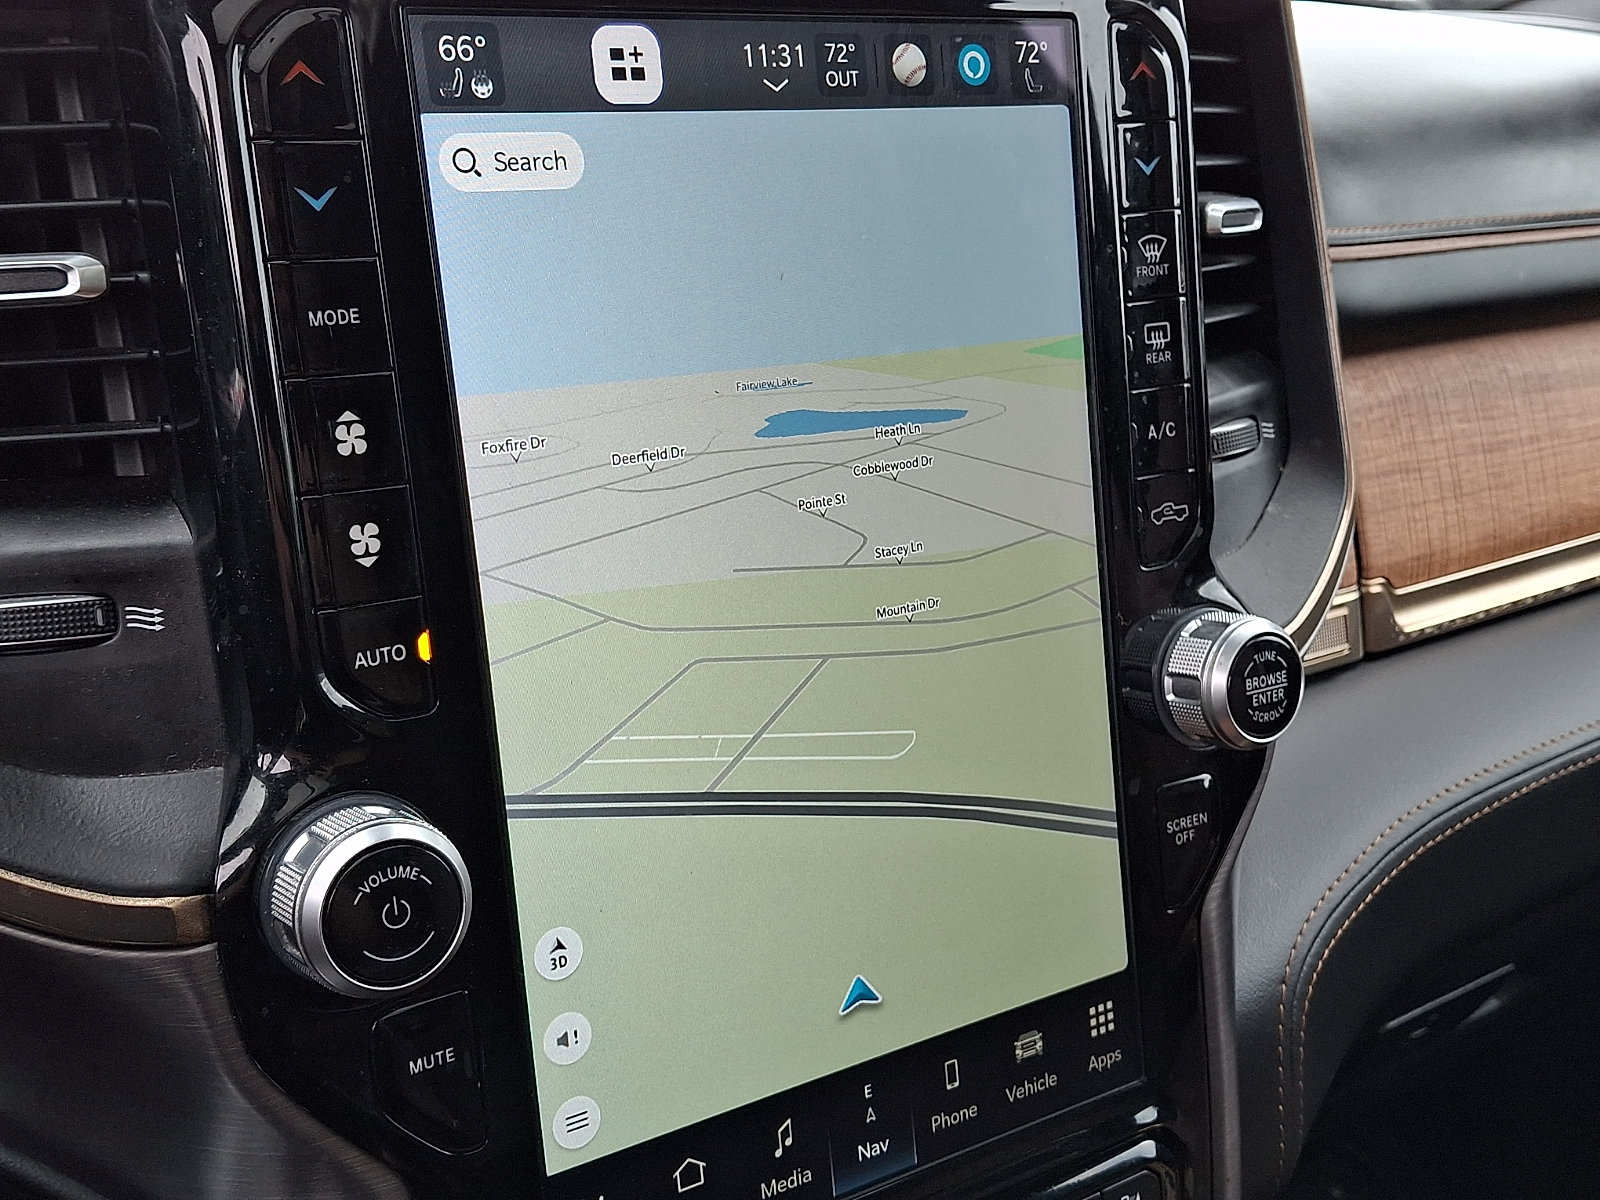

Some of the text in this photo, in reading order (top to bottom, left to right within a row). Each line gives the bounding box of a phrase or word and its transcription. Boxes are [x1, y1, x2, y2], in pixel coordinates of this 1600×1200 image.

[743, 42, 804, 69] 11:31
[825, 70, 860, 88] OUT
[493, 149, 568, 173] Search
[1135, 263, 1170, 278] FRONT
[307, 307, 361, 327] MODE
[1145, 350, 1172, 365] REAR
[736, 376, 798, 392] Fairview Lake
[874, 423, 921, 439] Heath Ln
[1148, 420, 1177, 440] A/C
[481, 436, 548, 455] Foxfire Dr
[611, 446, 686, 466] Deerfield Dr
[853, 455, 934, 476] Cobblewood Dr
[797, 493, 847, 511] Pointe St
[874, 540, 924, 559] Stacey Ln
[876, 597, 940, 619] Mountain Dr
[353, 643, 407, 670] AUTO
[1253, 650, 1277, 664] TUNE
[1245, 669, 1288, 691] BROWSE
[1252, 688, 1285, 707] ENTER
[1253, 706, 1284, 723] SCROLL
[1166, 811, 1208, 834] SCREEN
[1175, 829, 1195, 846] OFF
[358, 864, 422, 894] VOLUME
[549, 954, 568, 971] 3D
[408, 1046, 457, 1076] MUTE
[1088, 1046, 1123, 1072] Apps
[864, 1084, 873, 1100] E
[1005, 1070, 1058, 1103] Vehicle
[930, 1101, 978, 1134] Phone
[857, 1138, 890, 1163] Nav
[760, 1167, 813, 1199] Media
